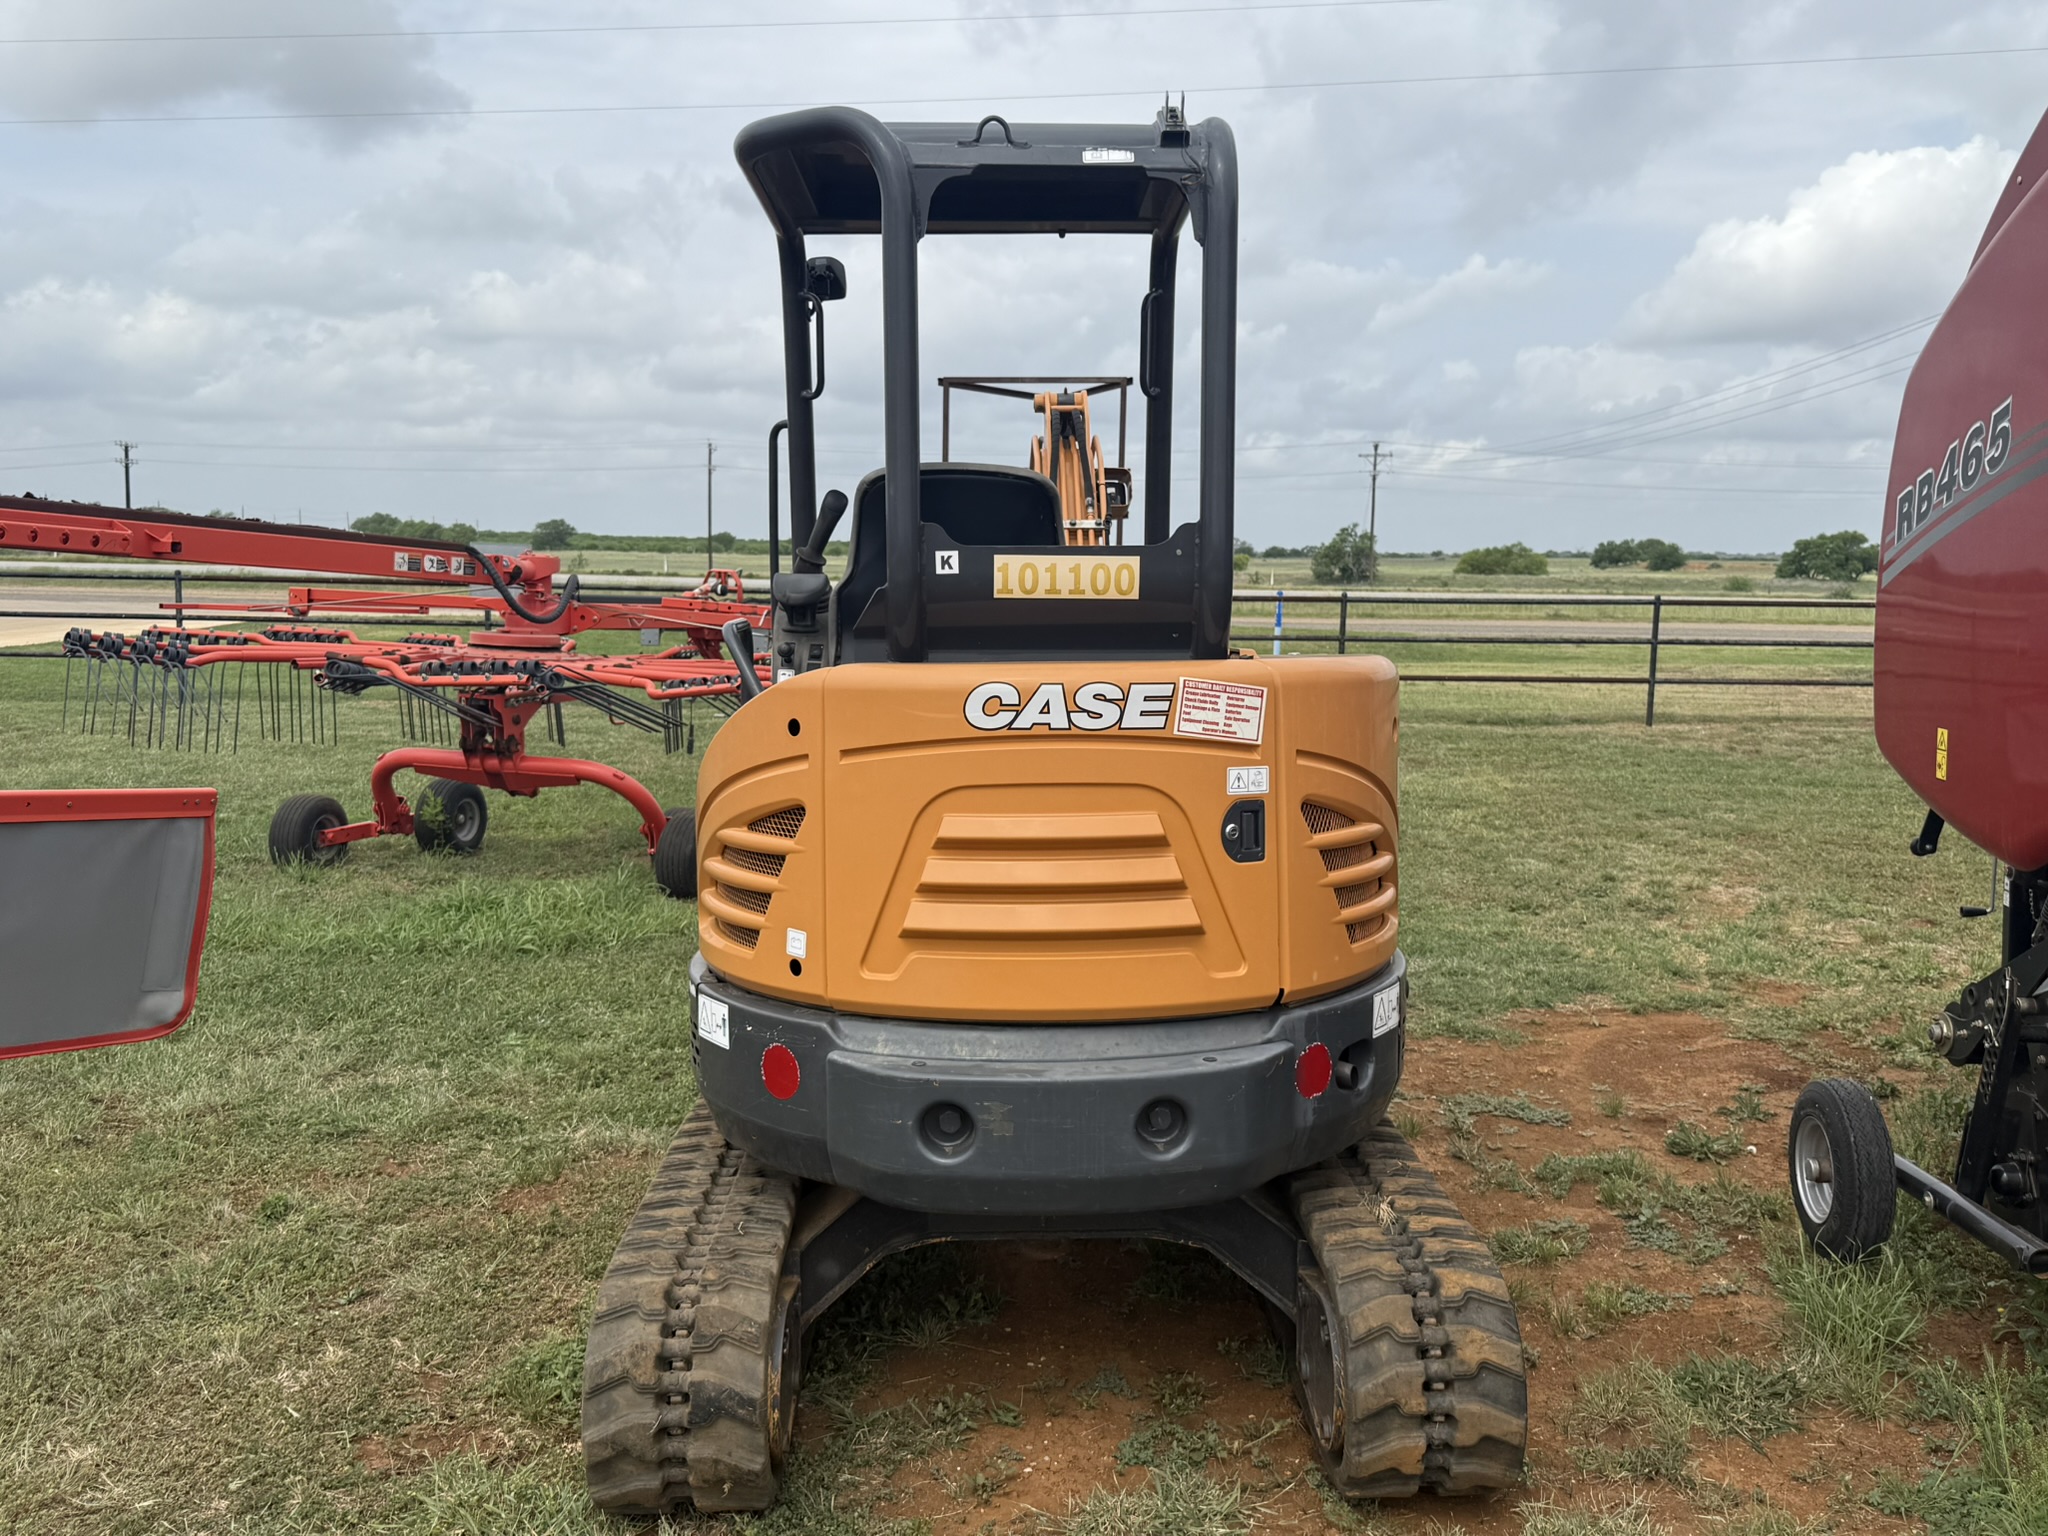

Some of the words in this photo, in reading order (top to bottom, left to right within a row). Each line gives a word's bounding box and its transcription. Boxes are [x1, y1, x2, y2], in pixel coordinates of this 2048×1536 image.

[1895, 395, 2012, 545] RB465
[940, 555, 953, 570] K
[996, 562, 1135, 596] 101100
[1185, 681, 1212, 689] CUSTOMER
[1226, 685, 1262, 696] RESPONSIBILITY
[964, 681, 1176, 731] CASE
